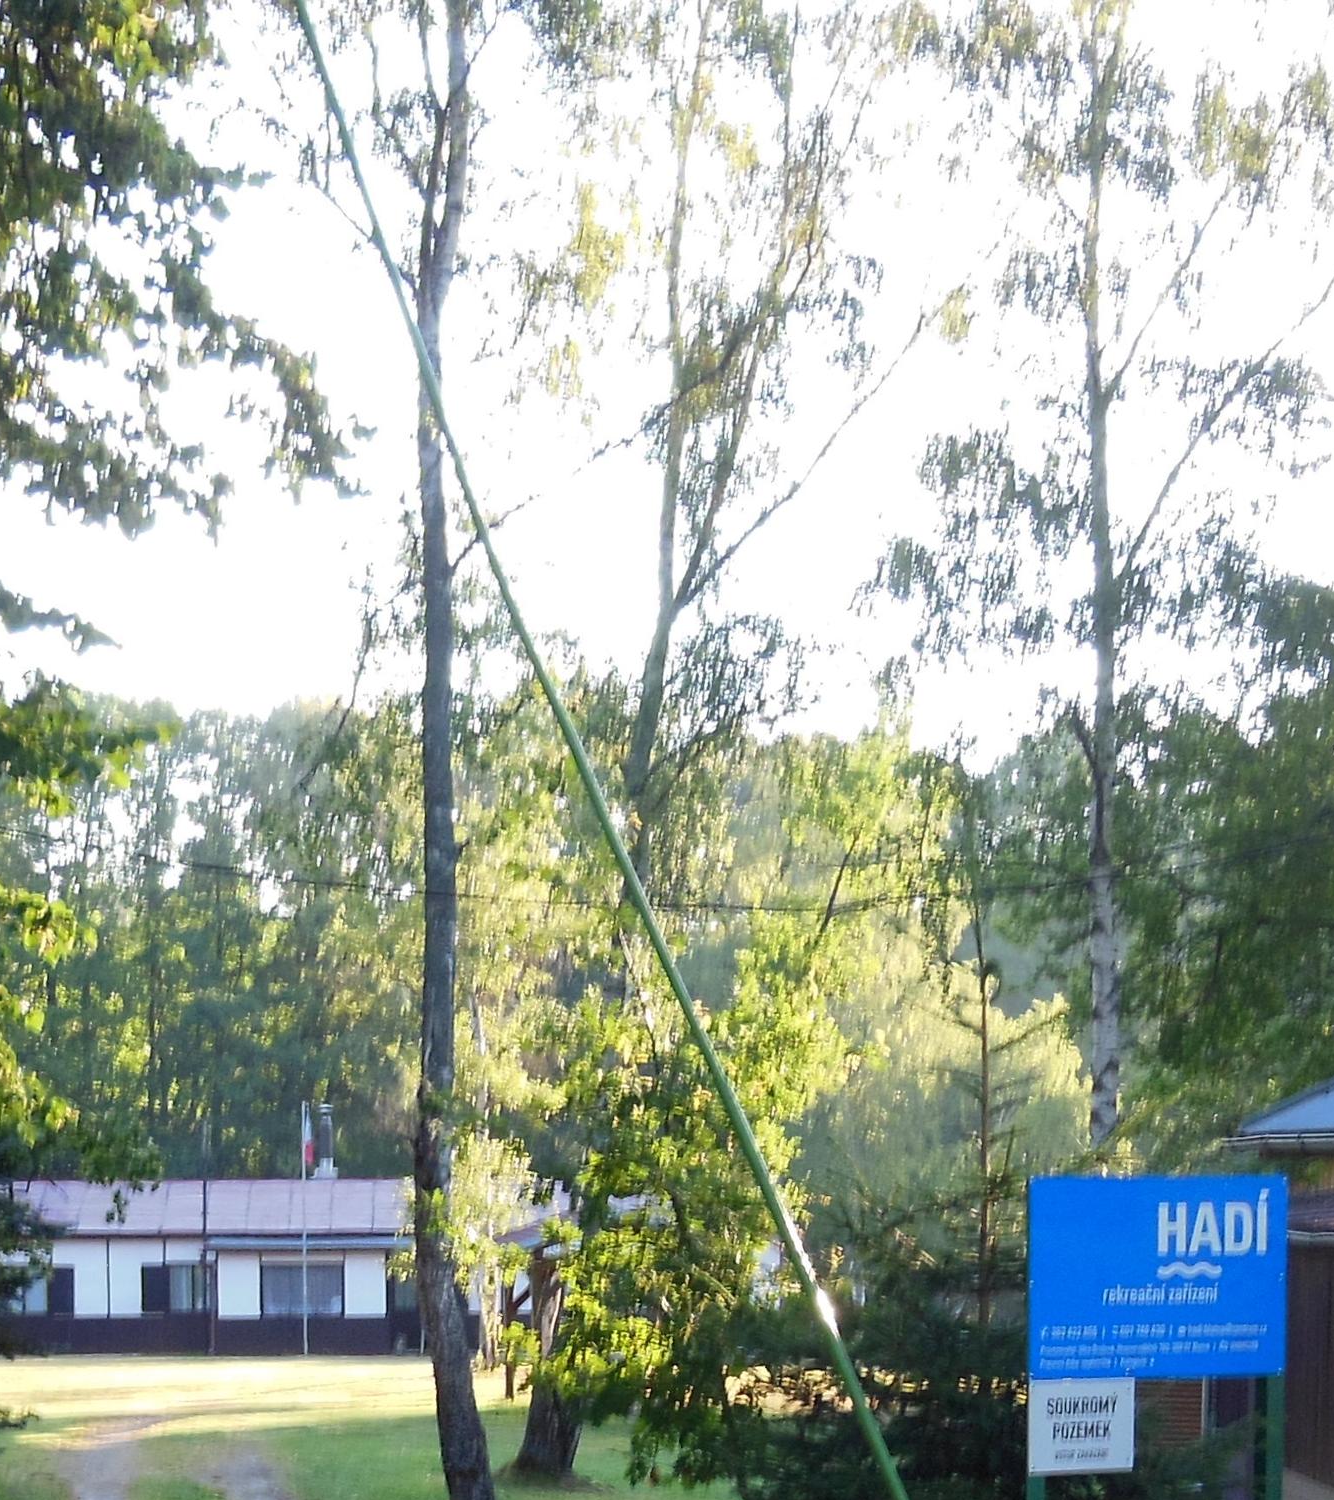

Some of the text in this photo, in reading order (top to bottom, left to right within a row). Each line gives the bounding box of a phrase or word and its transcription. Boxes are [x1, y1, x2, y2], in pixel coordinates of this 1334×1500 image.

[1157, 1188, 1269, 1257] HADÍ
[1102, 1282, 1219, 1306] rekreační zařízení
[1047, 1393, 1118, 1416] SOUKROMÝ
[1052, 1420, 1112, 1440] POZEMEK
